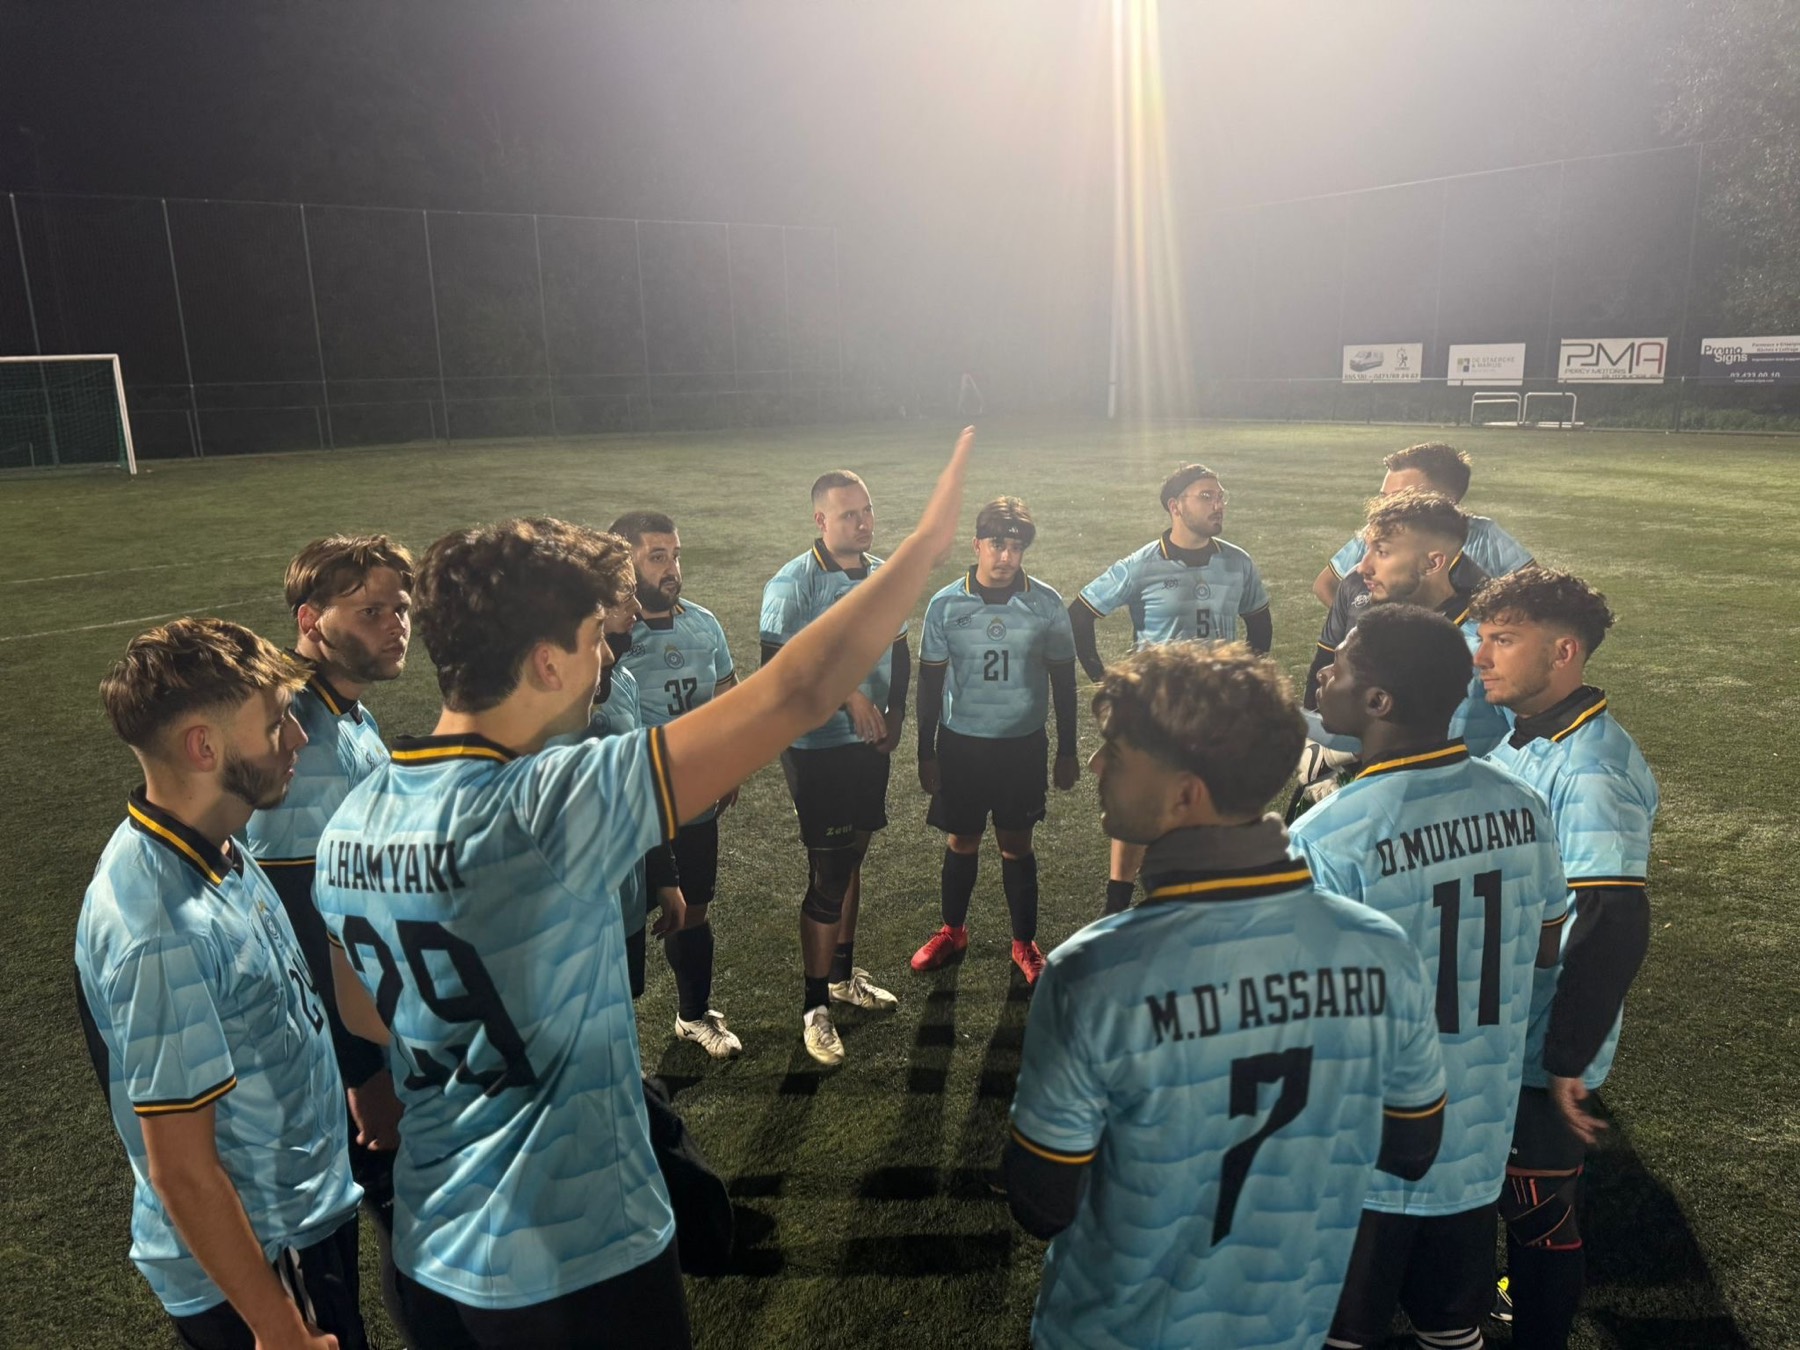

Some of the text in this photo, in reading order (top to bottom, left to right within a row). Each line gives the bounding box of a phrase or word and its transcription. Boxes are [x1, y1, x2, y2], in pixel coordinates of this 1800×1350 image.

[1561, 342, 1664, 374] PMA
[1704, 345, 1743, 355] Promo
[1714, 353, 1748, 365] Signs
[1196, 608, 1210, 639] 5
[983, 649, 1009, 682] 21
[664, 676, 698, 716] 37
[1432, 869, 1502, 1035] 11
[342, 914, 540, 1098] 29
[1209, 1045, 1314, 1248] 7
